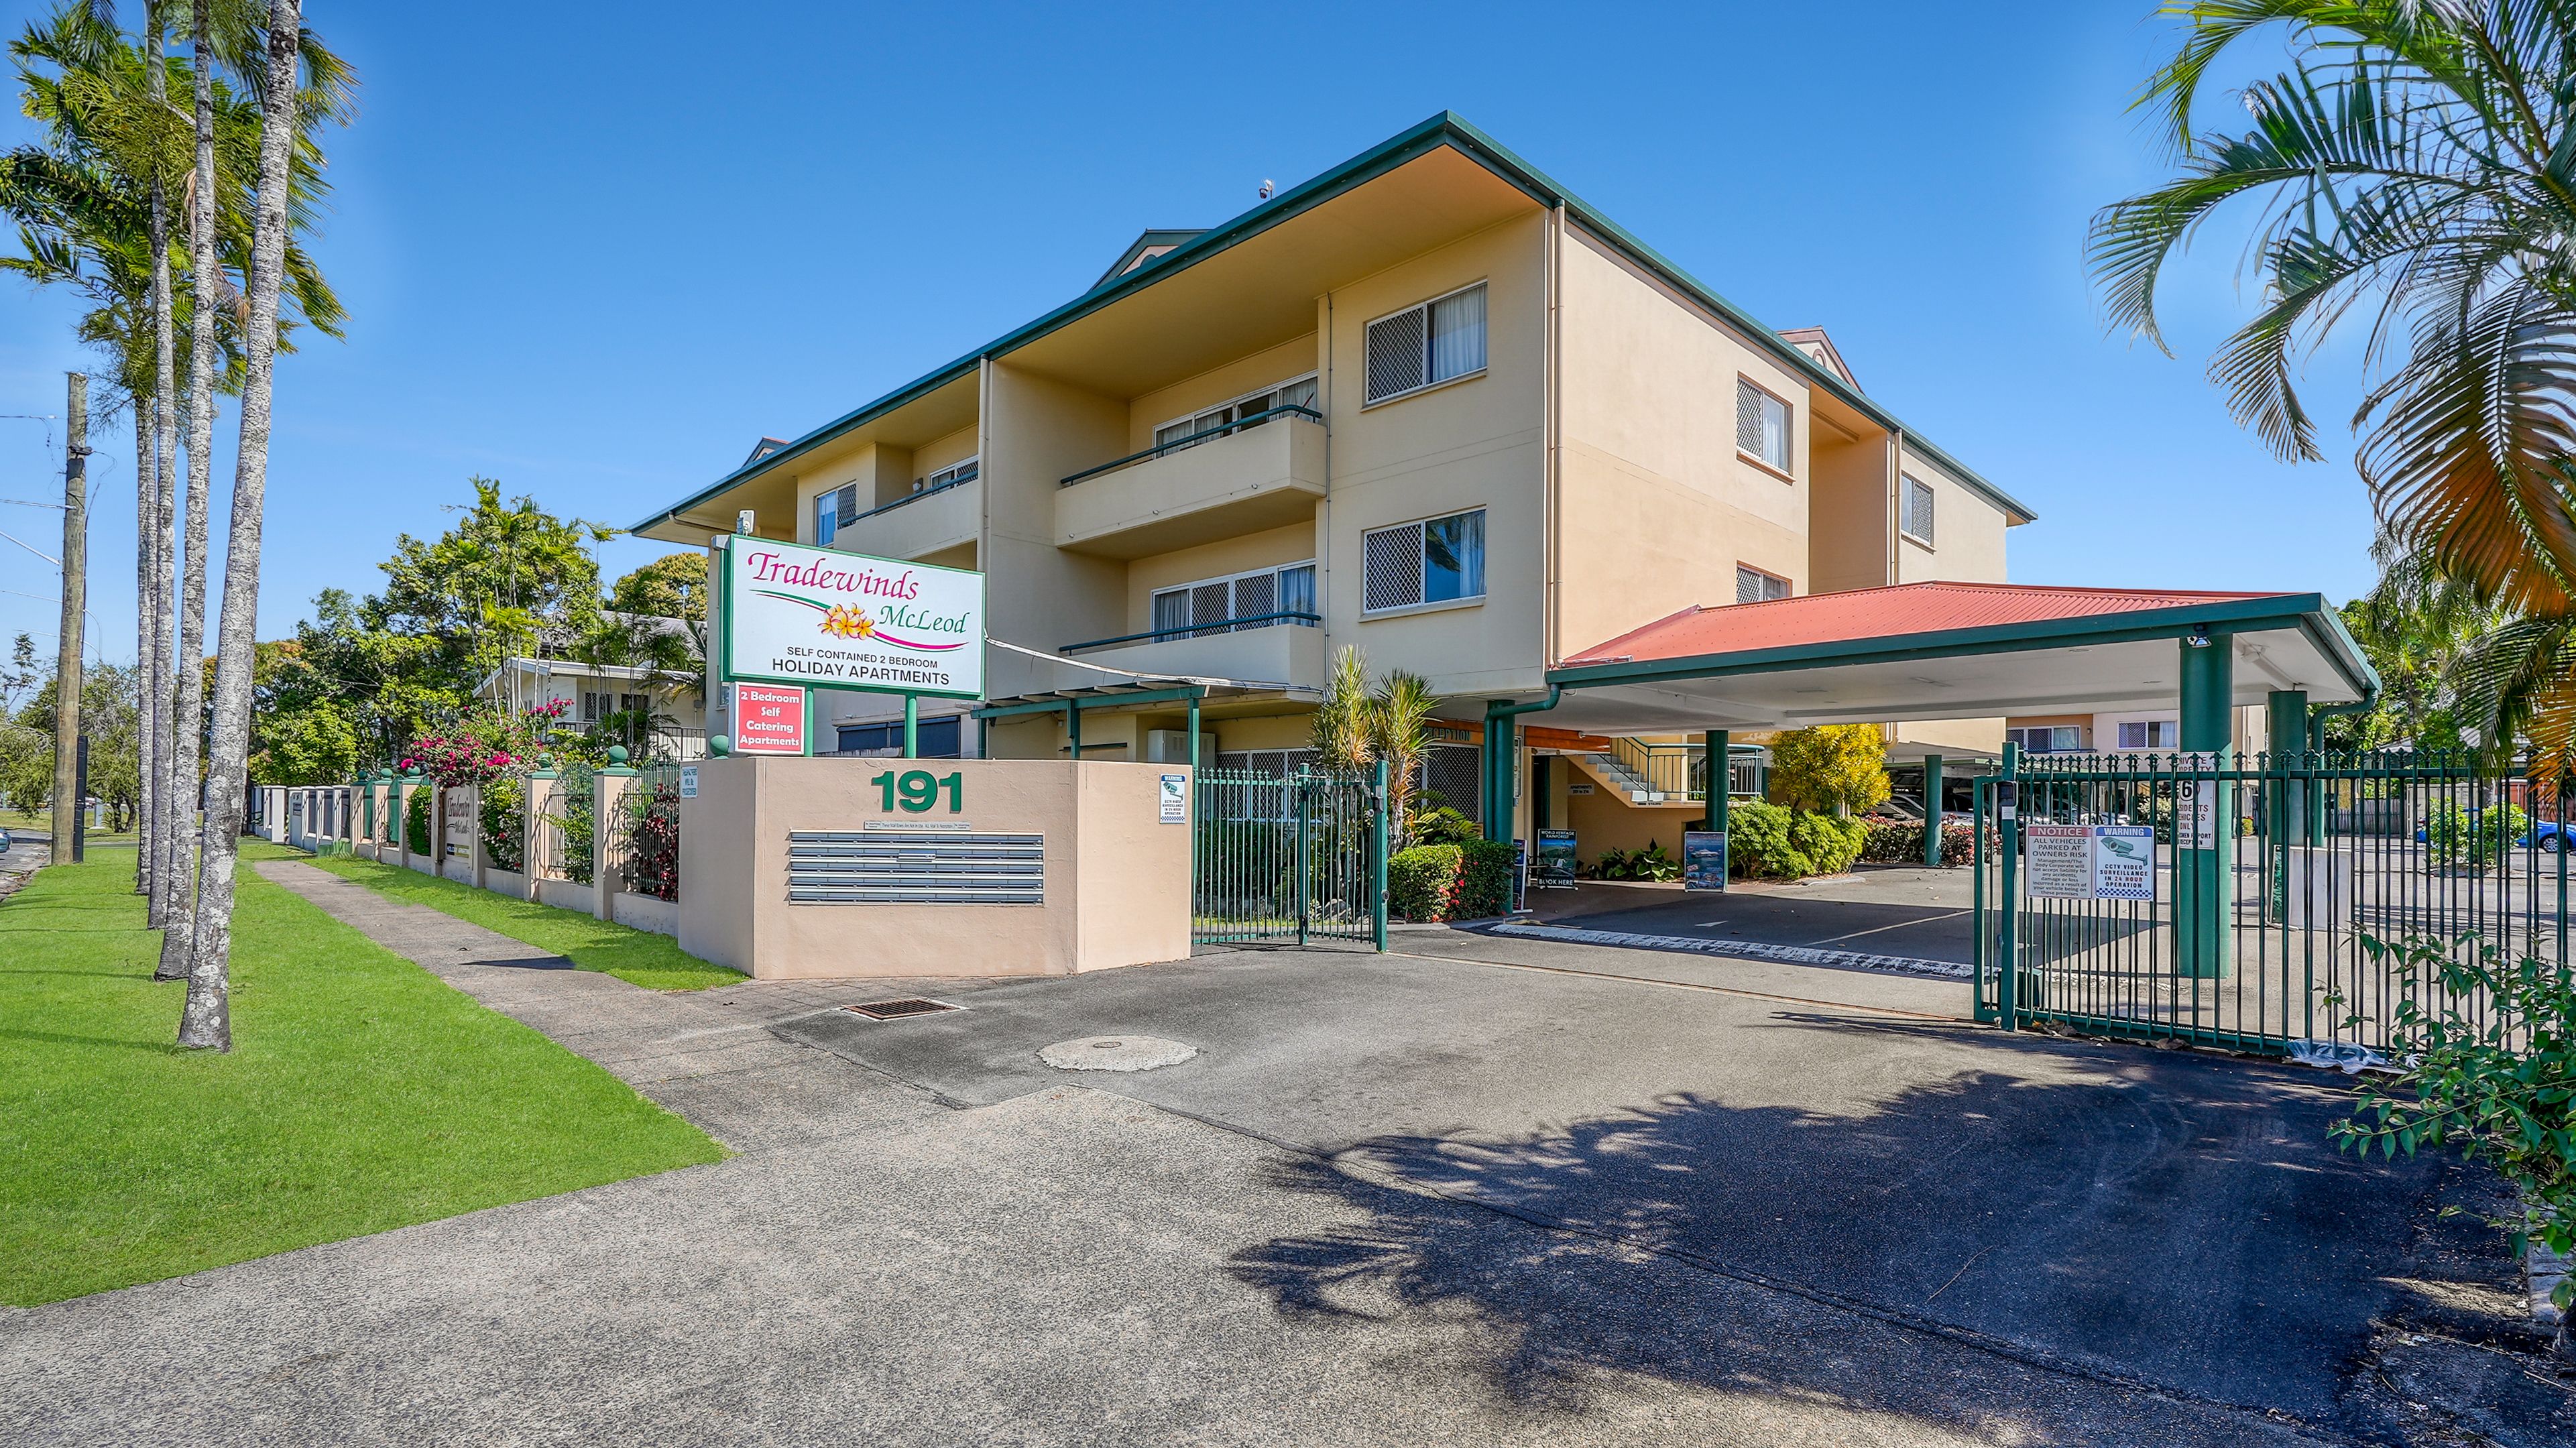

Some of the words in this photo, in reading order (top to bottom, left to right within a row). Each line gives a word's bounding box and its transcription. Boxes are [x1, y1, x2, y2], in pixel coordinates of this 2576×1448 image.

[748, 552, 920, 600] Tradewinds
[879, 605, 970, 634] McLeod
[787, 646, 814, 657] SELF
[817, 649, 878, 663] CONTAINED
[880, 656, 886, 664] 2
[889, 657, 938, 668] BEDROOM
[772, 658, 844, 676] HOLIDAY
[848, 665, 950, 685] APARTMENTS
[740, 691, 748, 701] 2
[750, 690, 800, 703] Bedroom
[761, 706, 780, 717] Self
[746, 720, 794, 733] Catering
[1421, 726, 1470, 741] RECEPTION
[740, 734, 799, 746] Apartments
[870, 770, 961, 814] 191
[2038, 827, 2083, 836] NOTICE
[2103, 827, 2145, 836] WARNING
